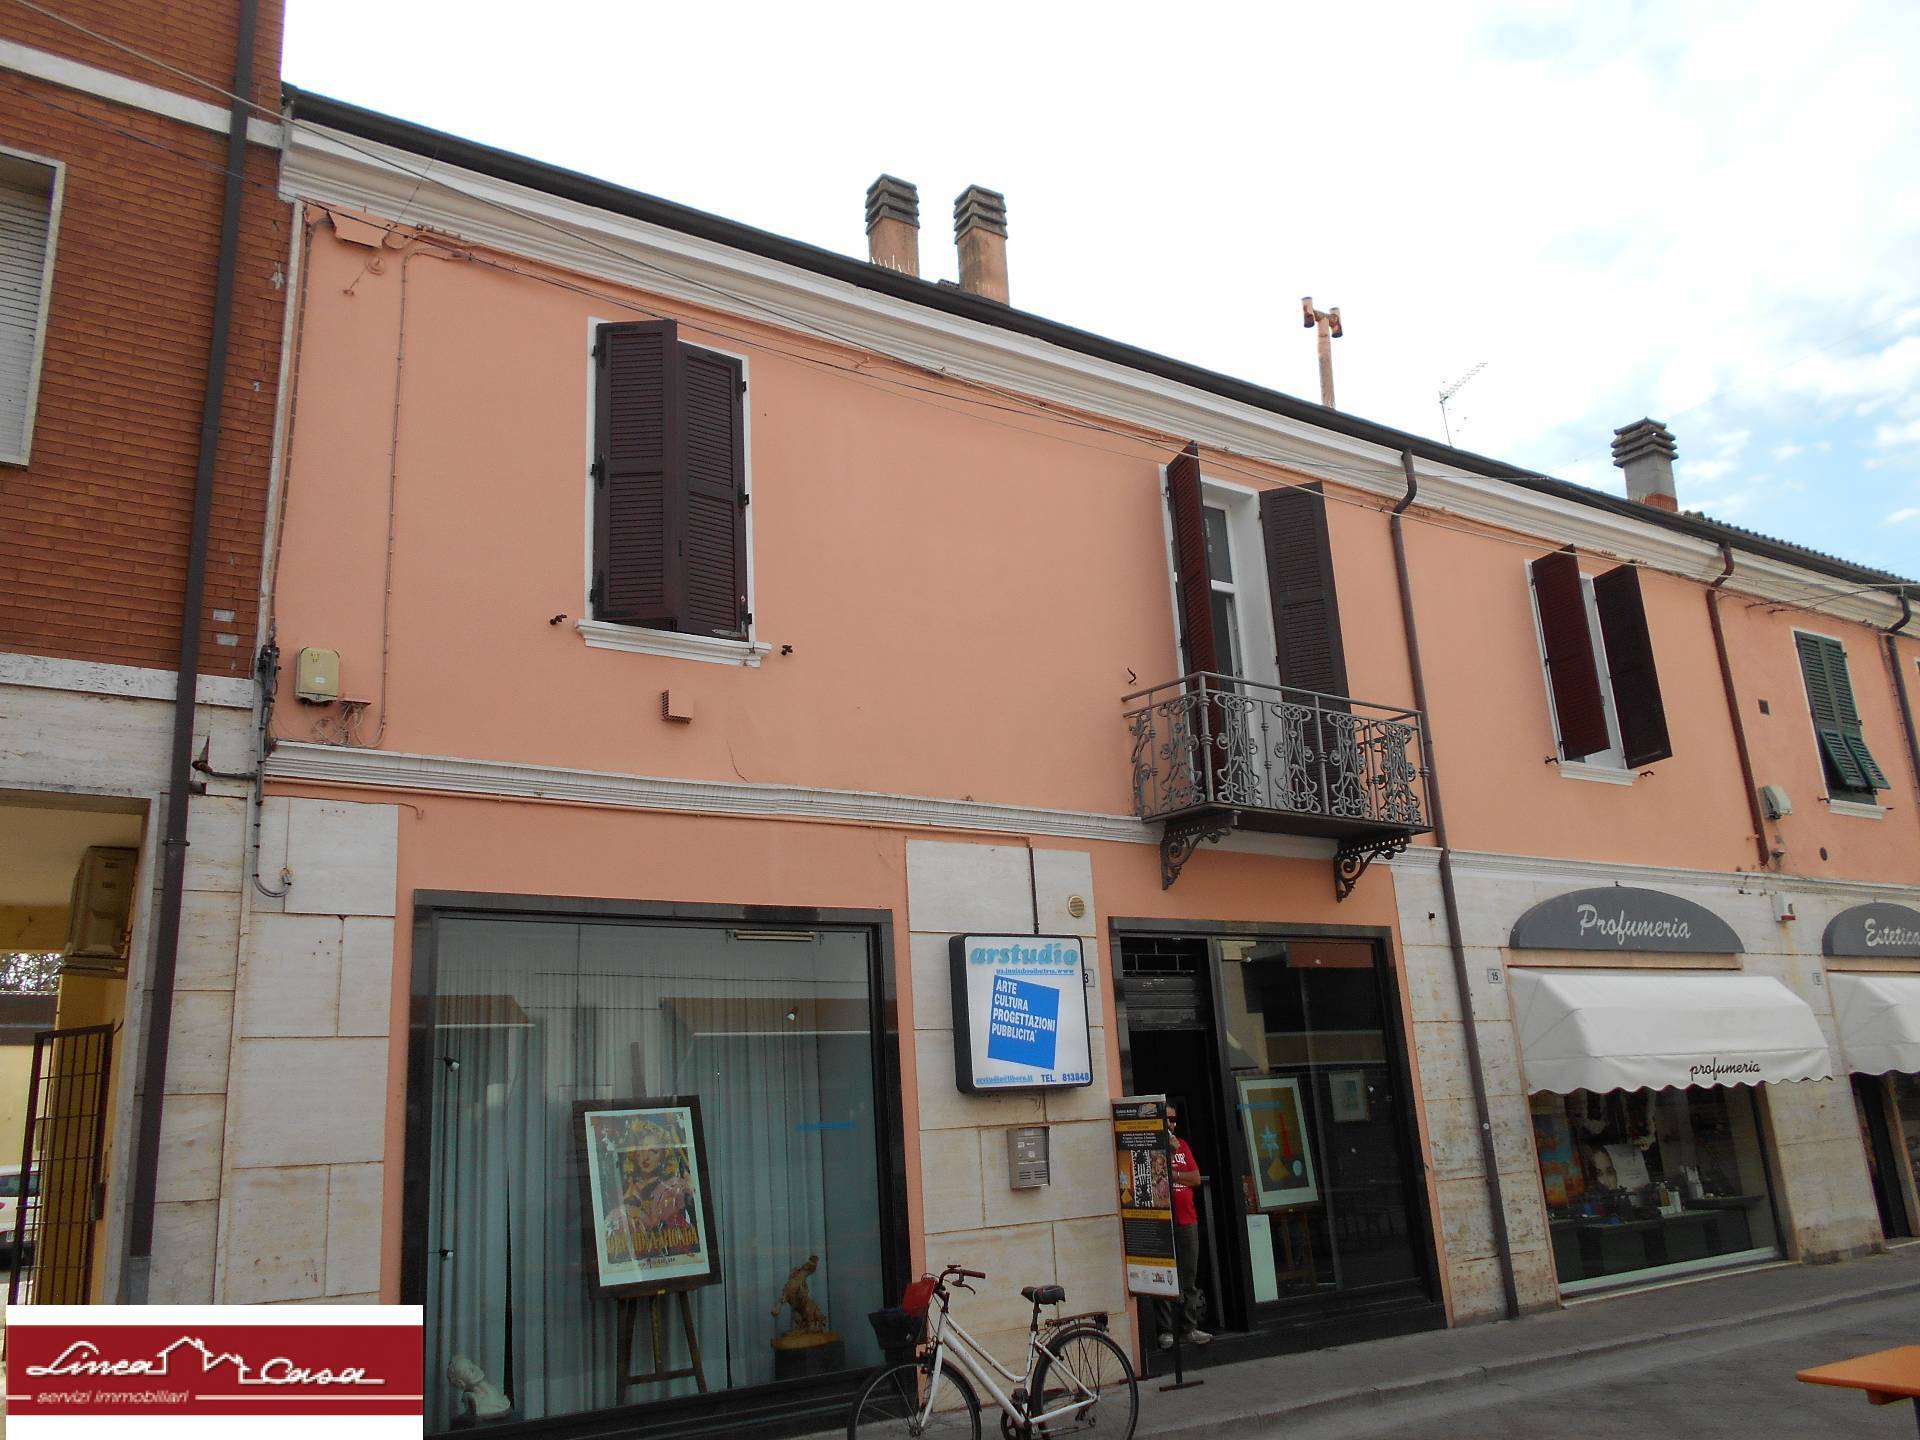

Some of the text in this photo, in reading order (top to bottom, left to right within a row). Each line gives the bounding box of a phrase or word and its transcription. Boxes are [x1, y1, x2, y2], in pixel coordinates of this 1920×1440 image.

[1577, 904, 1691, 945] Profumeria
[970, 943, 1078, 965] arstudio
[1491, 971, 1499, 981] 15
[996, 979, 1018, 995] ARTE
[994, 993, 1029, 1012] CULTURA
[993, 1007, 1056, 1032] PROGETTAZIONI
[1041, 1073, 1057, 1083] TEL.
[1690, 1057, 1761, 1081] profumeria
